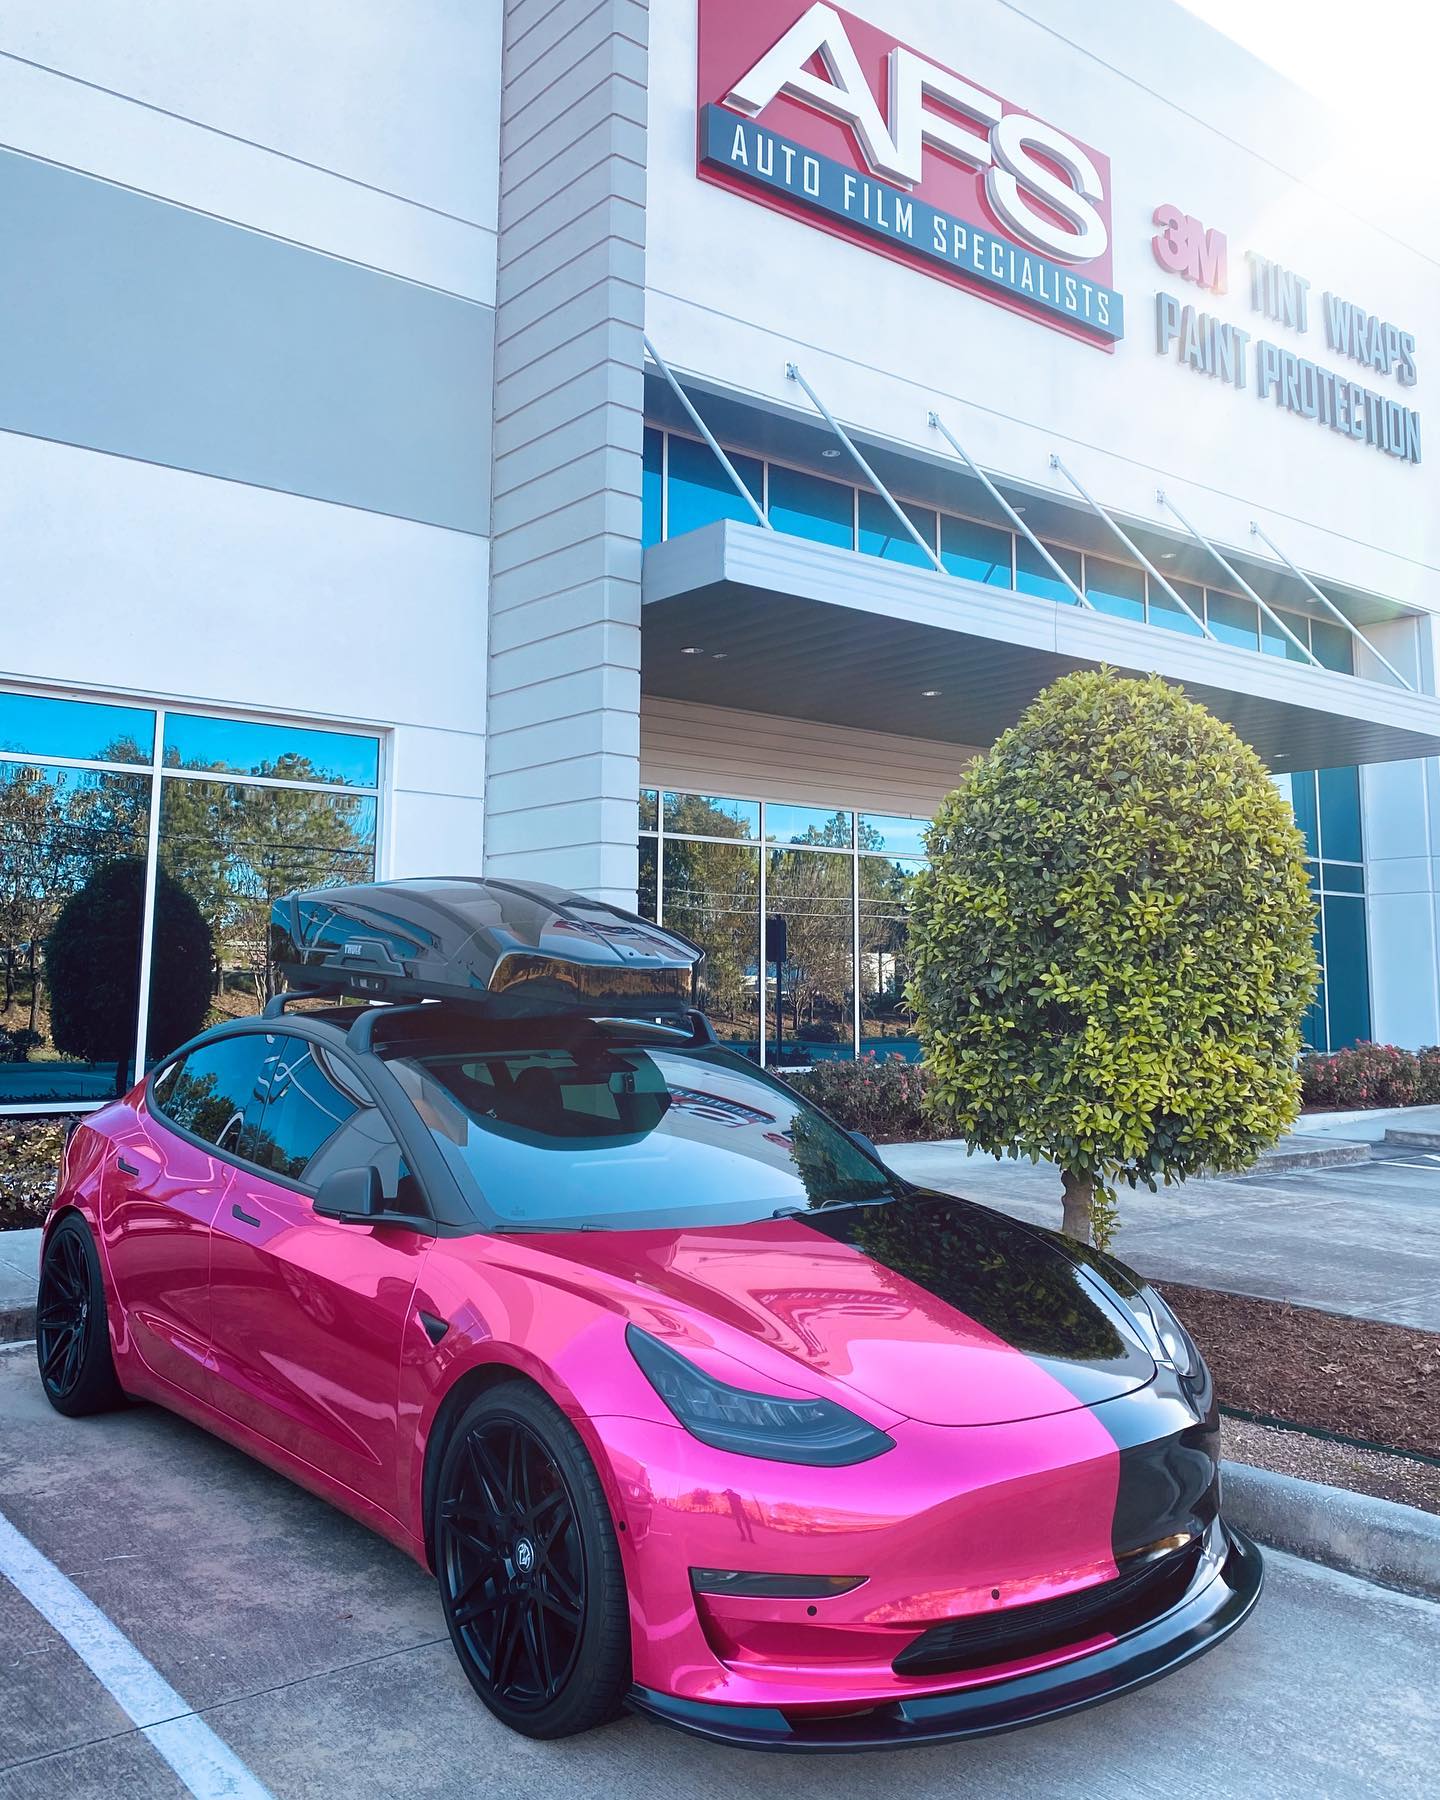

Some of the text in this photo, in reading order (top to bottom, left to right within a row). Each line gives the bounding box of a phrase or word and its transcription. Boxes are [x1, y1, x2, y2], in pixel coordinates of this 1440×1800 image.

[722, 1, 1108, 264] AFS
[731, 124, 1109, 325] AUTO FILM SPECIALISTS
[1152, 203, 1417, 386] 3M TINT WRAPS
[1156, 291, 1422, 465] PAINT PROTECTION
